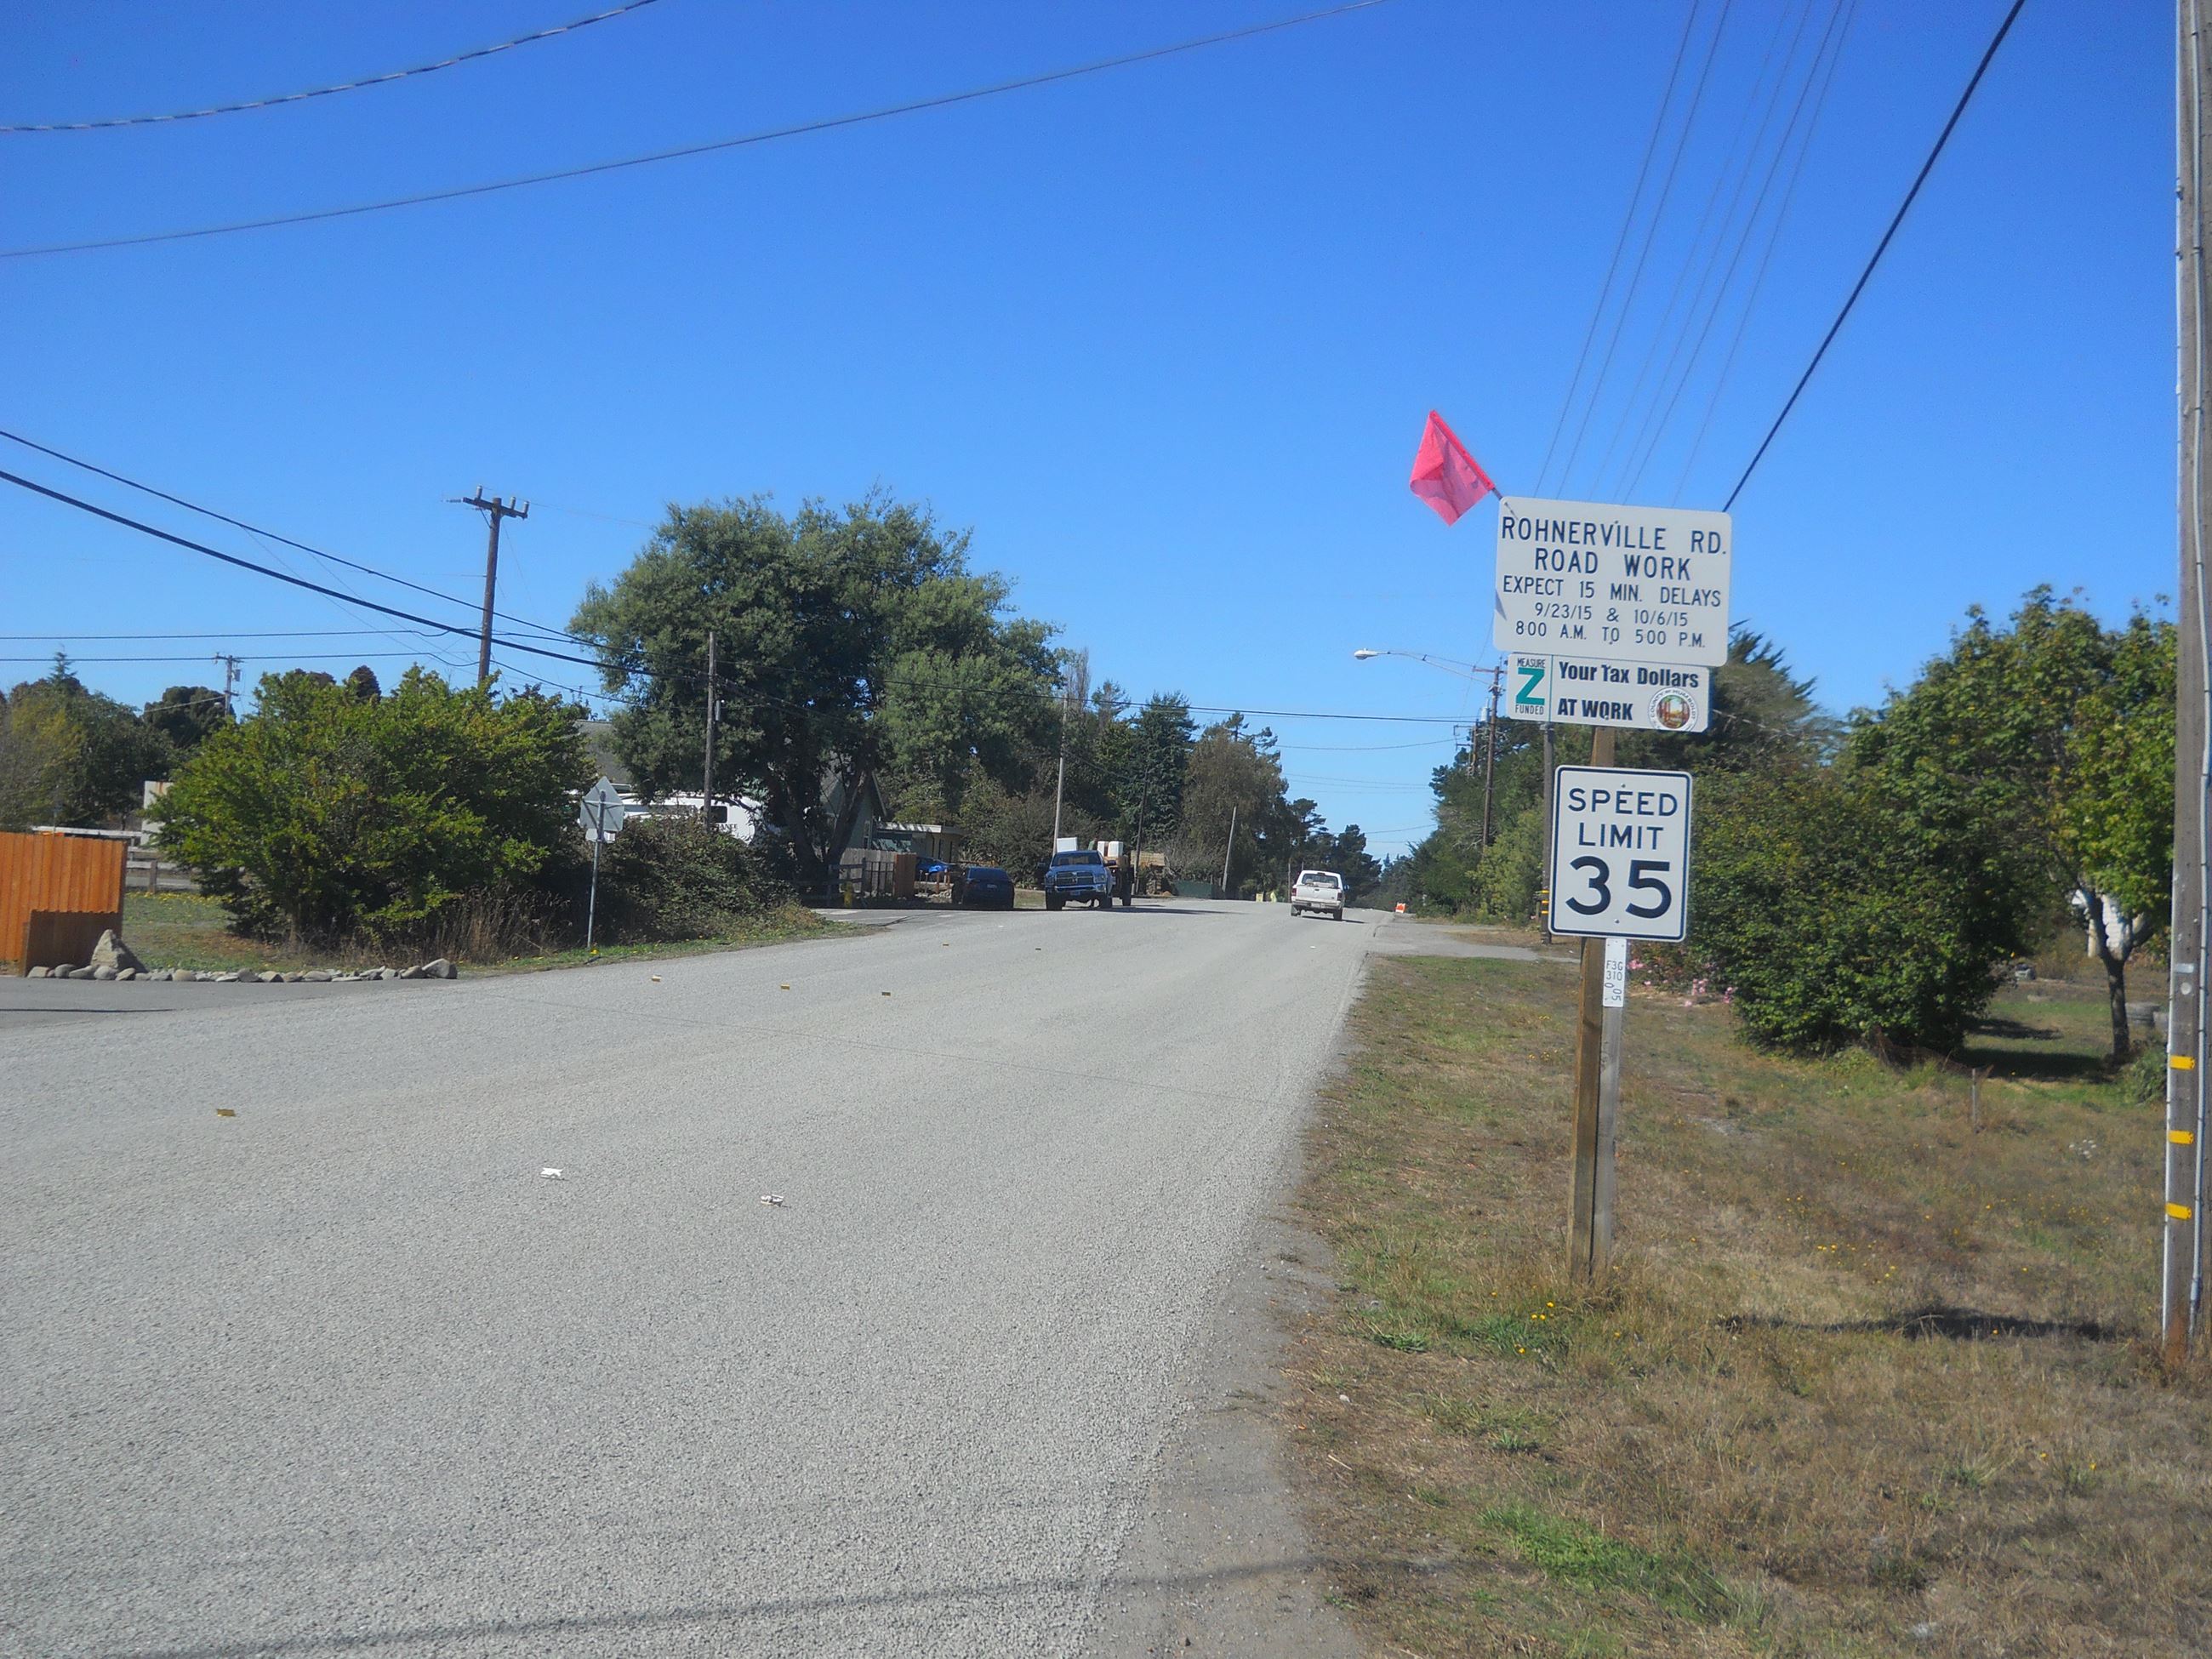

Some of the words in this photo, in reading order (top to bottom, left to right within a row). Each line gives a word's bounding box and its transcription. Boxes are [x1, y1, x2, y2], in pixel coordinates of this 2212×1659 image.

[1502, 516, 1666, 550] ROHNERVILLE
[1690, 530, 1726, 555] RD.
[1535, 547, 1598, 573] ROAD
[1624, 554, 1690, 580] WORK
[1503, 575, 1564, 596] EXPECT
[1580, 581, 1594, 598] 15
[1611, 583, 1643, 602] MIN.
[1661, 587, 1721, 607] DELAYS
[1535, 602, 1592, 620] 9/23/15
[1606, 607, 1619, 622] &
[1634, 609, 1688, 626] 10/6/15
[1560, 624, 1587, 640] A.M.
[1602, 627, 1620, 642] TO
[1679, 632, 1706, 647] P.M.
[1517, 658, 1546, 668] MEASURE
[1559, 661, 1597, 681] Your
[1601, 664, 1629, 683] Tax
[1637, 667, 1698, 688] Dollars
[1516, 667, 1545, 705] Z
[1515, 704, 1544, 715] FUNDED
[1558, 698, 1577, 715] AT
[1582, 700, 1633, 721] WORK
[1568, 788, 1678, 817] SPEED
[1579, 822, 1664, 850] LIMIT
[1565, 855, 1672, 919] 35
